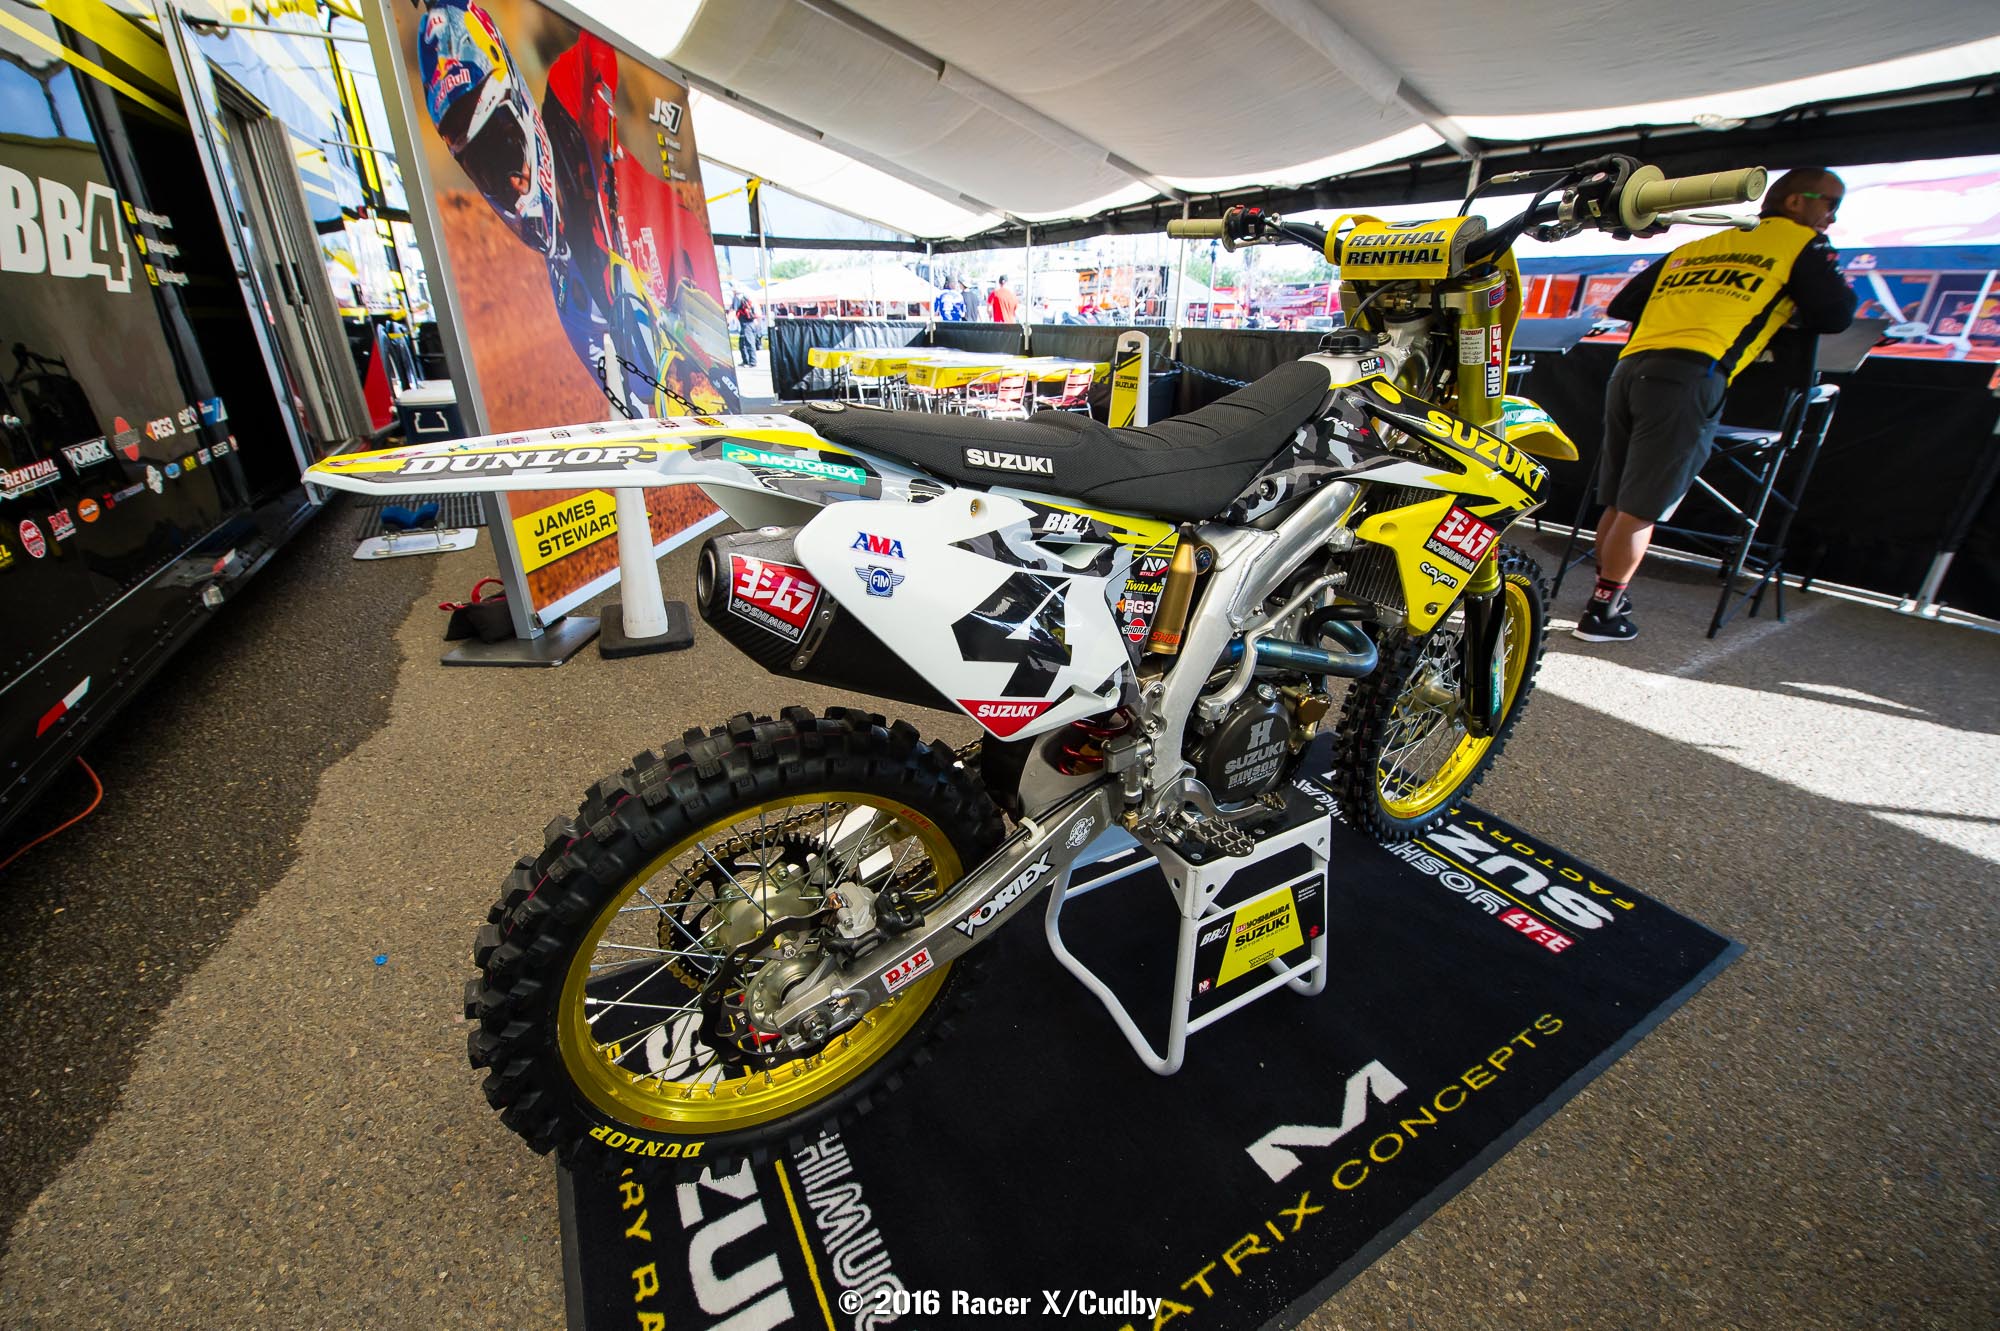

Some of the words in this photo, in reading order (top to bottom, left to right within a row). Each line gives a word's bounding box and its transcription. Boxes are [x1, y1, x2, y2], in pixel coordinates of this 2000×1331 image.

[445, 67, 472, 90] Bull
[648, 96, 683, 135] JS7
[0, 164, 132, 293] BB4
[1348, 230, 1446, 247] RENTHAL
[1346, 248, 1444, 264] RENTHAL
[1657, 269, 1764, 293] SUZUKI
[1695, 287, 1752, 302] RACING
[1492, 326, 1501, 362] SFF
[1361, 359, 1377, 372] elf
[1487, 365, 1501, 395] AIR
[62, 442, 112, 476] VORTEX
[400, 447, 641, 475] DUNLOP
[966, 448, 1054, 475] SUZUKI
[1425, 410, 1544, 492] SUZUKI
[2, 459, 59, 489] RENTHAL
[759, 453, 859, 481] MOTOREX
[534, 499, 596, 537] JAMES
[1042, 512, 1093, 536] BB4
[1436, 509, 1494, 557] ヨシムラ
[850, 531, 905, 559] AMA
[1426, 538, 1476, 572] YOSHIMURA
[736, 557, 815, 615] ヨシムラ
[872, 575, 889, 588] FIM
[1125, 580, 1149, 592] Twin
[1148, 581, 1163, 593] Air
[732, 598, 799, 638] YOSHIMURA
[1124, 600, 1154, 615] RG3
[950, 571, 1073, 698] 4
[1122, 625, 1150, 635] SHORA
[976, 703, 1038, 718] SUZUKI
[1246, 718, 1275, 751] H
[1224, 740, 1286, 775] SUZUKI
[1228, 757, 1279, 786] HINSON
[1465, 819, 1636, 911] FACTORY
[955, 850, 1053, 937] VORTEX
[1235, 913, 1290, 948] SUZUKI
[588, 1124, 705, 1159] DUNLOP
[1117, 1190, 1325, 1331] ATRIX
[1331, 1012, 1565, 1191] CONCEPTS
